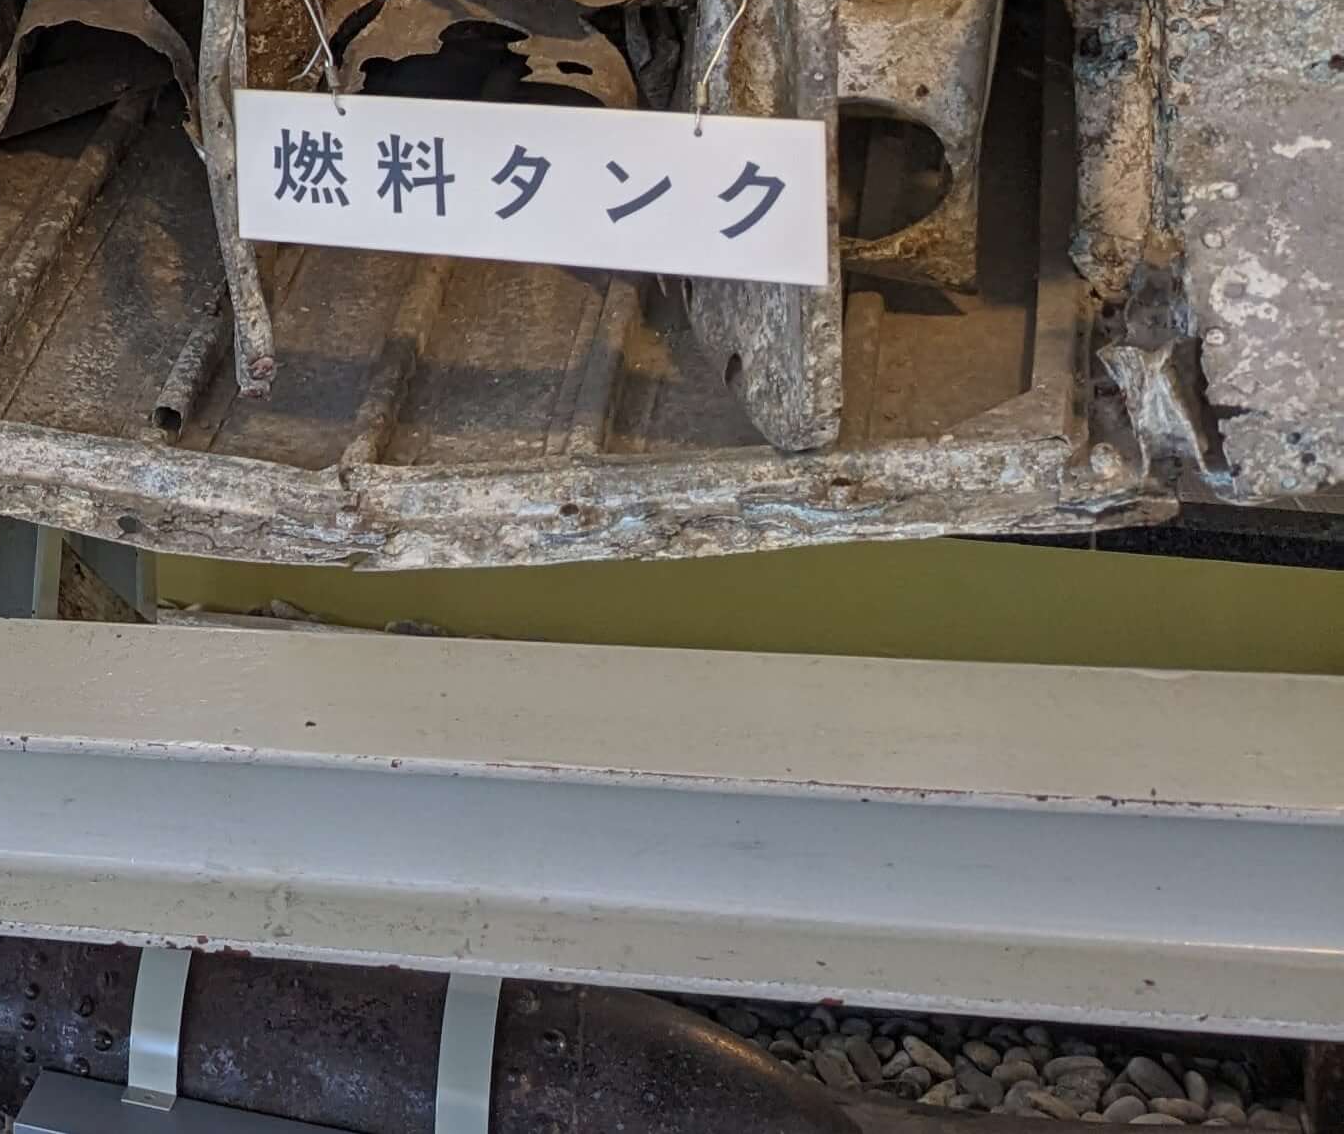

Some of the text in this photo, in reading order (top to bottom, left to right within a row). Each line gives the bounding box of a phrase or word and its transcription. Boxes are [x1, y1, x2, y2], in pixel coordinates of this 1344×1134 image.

[272, 128, 787, 240] 燃料タンク
